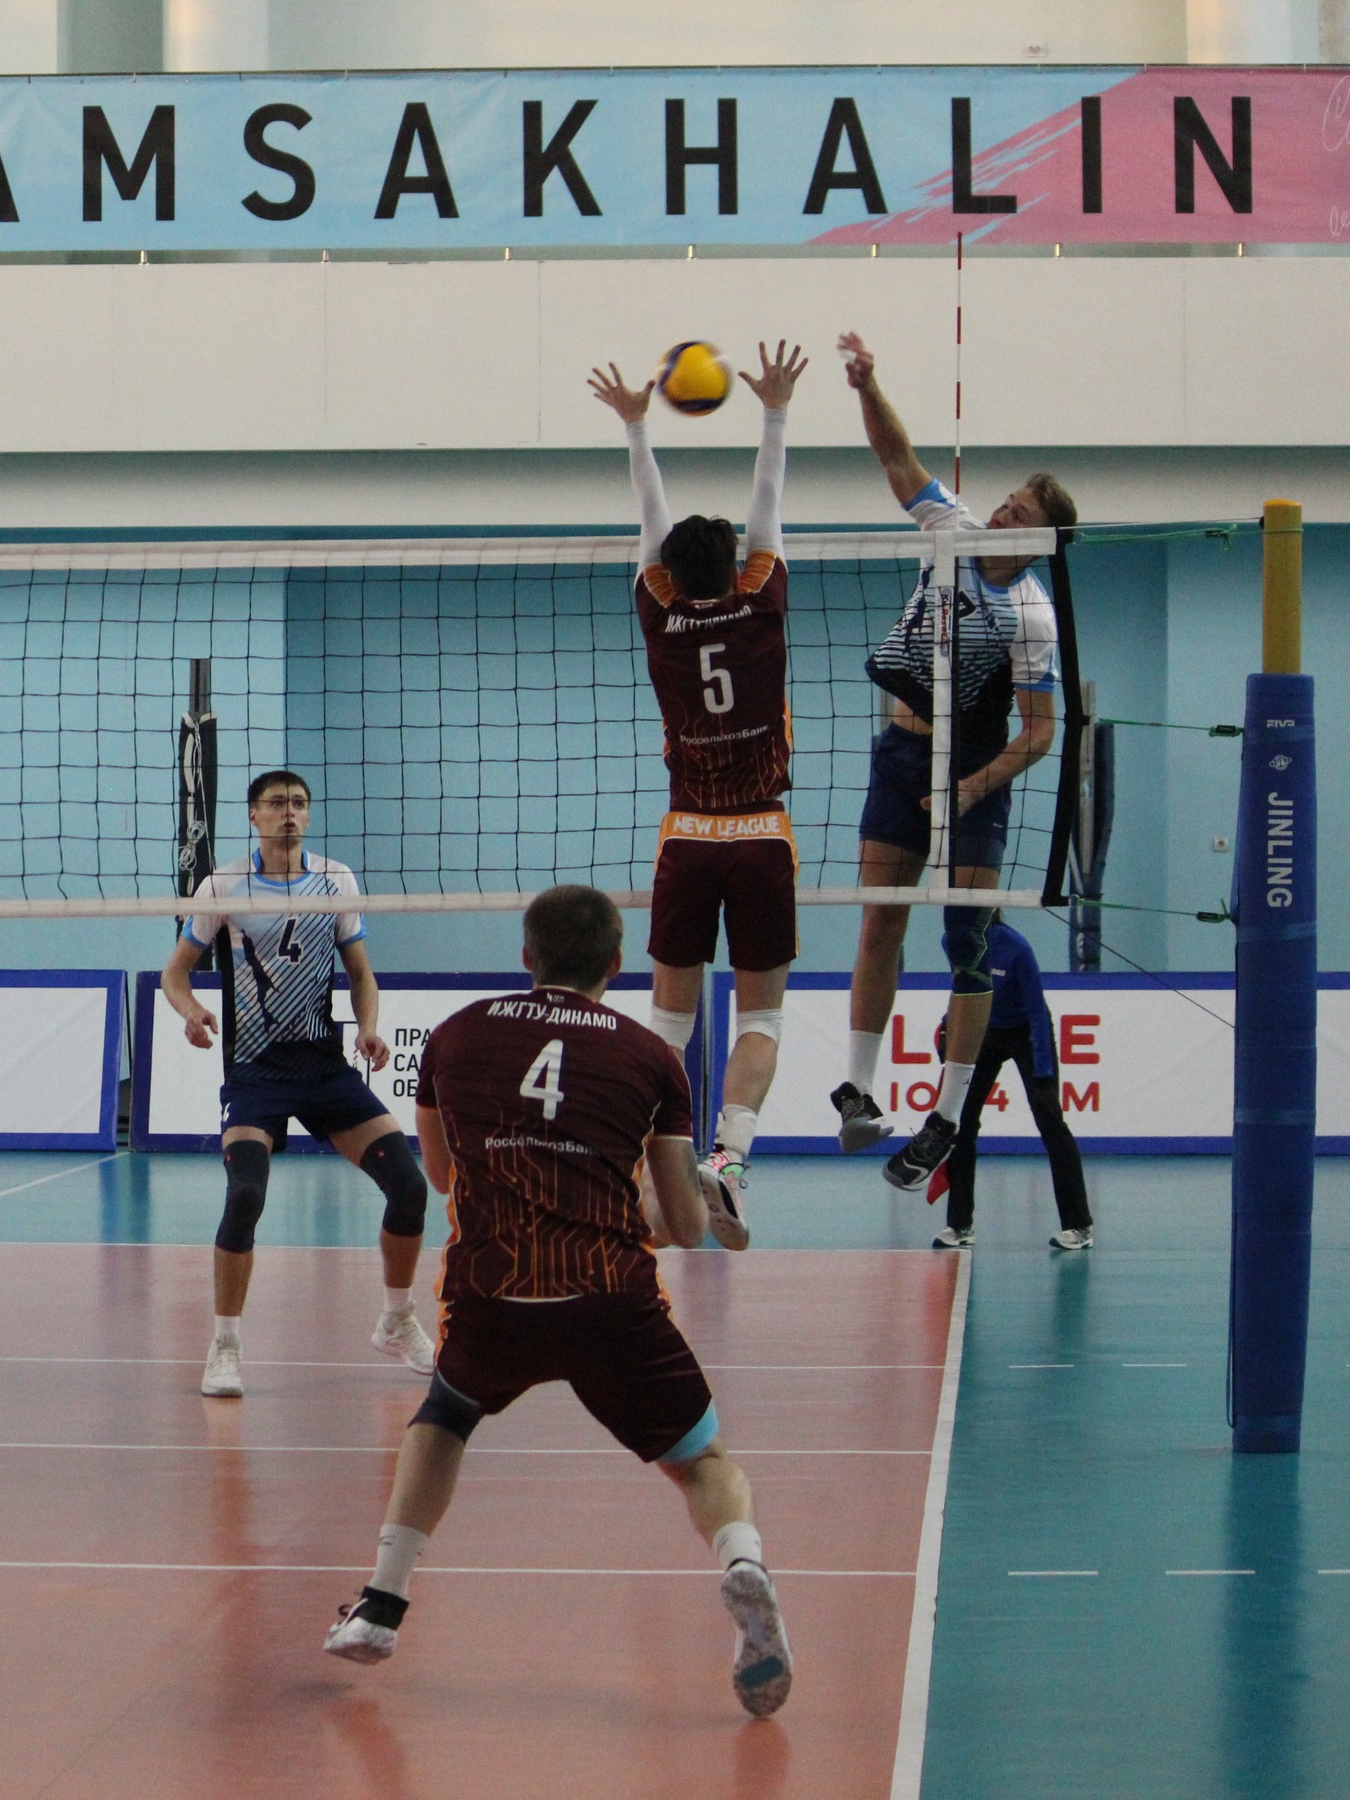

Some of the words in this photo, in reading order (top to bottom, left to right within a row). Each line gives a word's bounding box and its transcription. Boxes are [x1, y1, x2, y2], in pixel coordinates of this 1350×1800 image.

[699, 643, 735, 714] 5
[673, 815, 713, 836] NEW
[717, 815, 781, 836] LEAGUE
[1266, 791, 1294, 908] JINLING
[278, 917, 302, 963] 4
[486, 1000, 618, 1031] ИЖГТУ-ДИНАМО
[519, 1039, 564, 1120] 4
